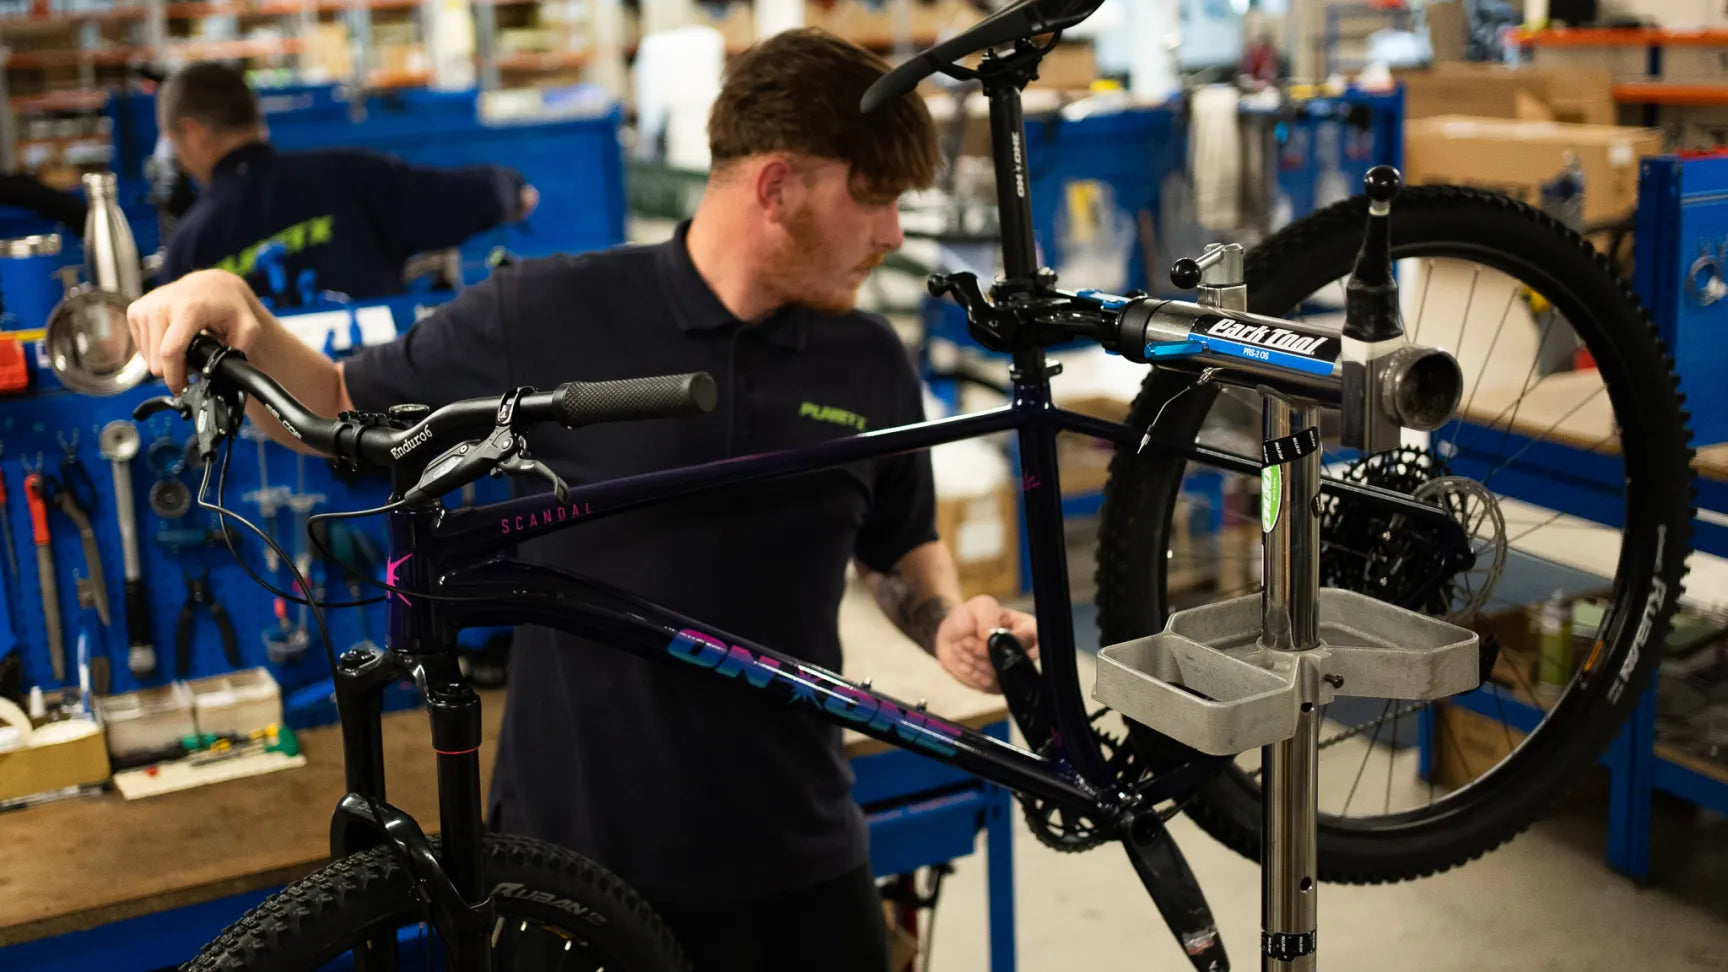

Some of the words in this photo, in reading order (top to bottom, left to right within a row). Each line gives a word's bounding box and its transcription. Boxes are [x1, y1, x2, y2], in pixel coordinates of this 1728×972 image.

[1207, 318, 1271, 344] Park
[390, 424, 432, 459] Enduro6
[501, 502, 592, 534] SCANDAL
[666, 628, 781, 688] ON
[823, 685, 962, 756] ONE
